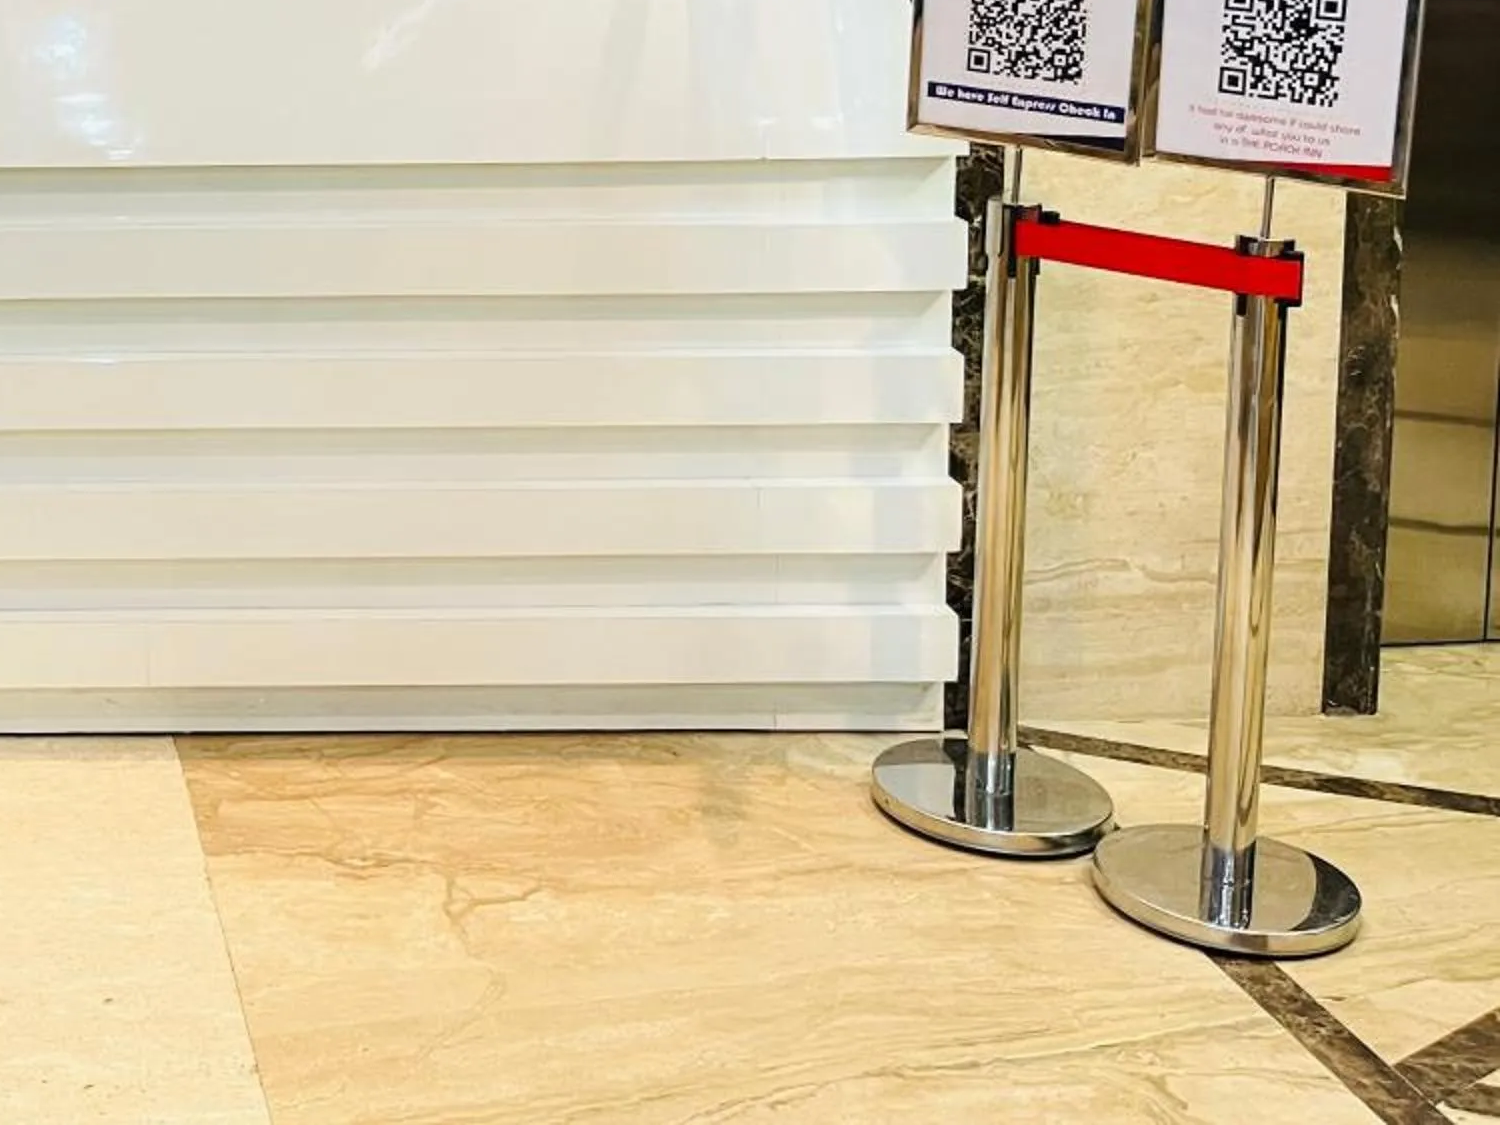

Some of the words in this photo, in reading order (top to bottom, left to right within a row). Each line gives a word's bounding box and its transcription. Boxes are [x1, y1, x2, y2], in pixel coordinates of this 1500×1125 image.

[935, 85, 953, 97] We
[957, 88, 984, 102] have
[1059, 103, 1101, 118] Check
